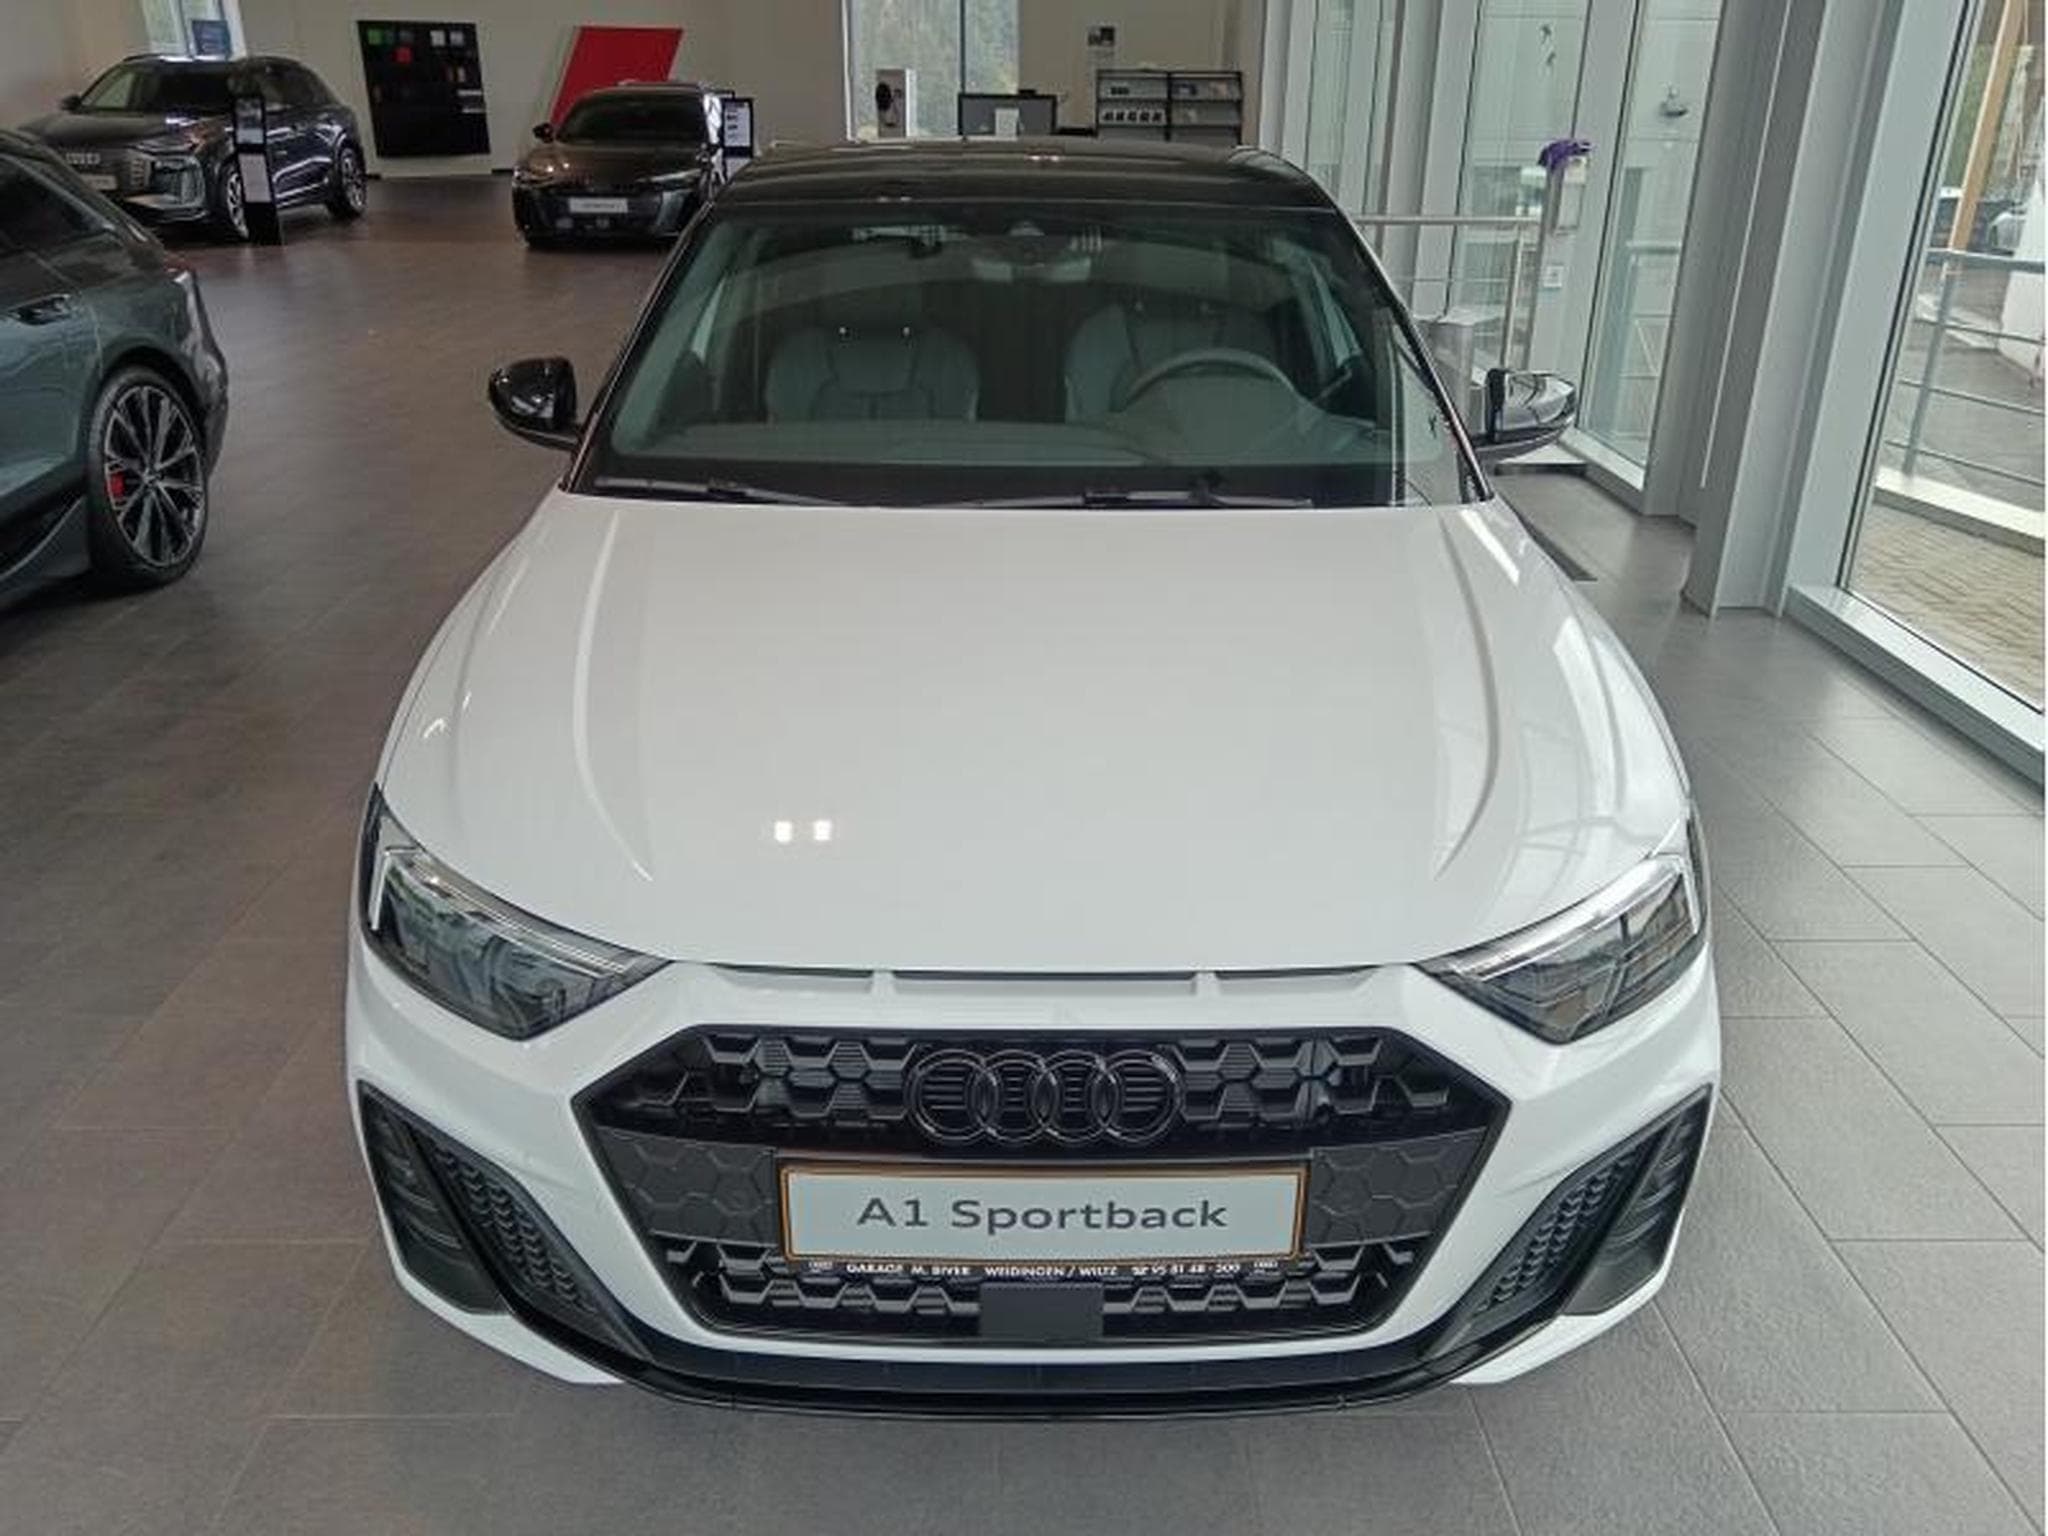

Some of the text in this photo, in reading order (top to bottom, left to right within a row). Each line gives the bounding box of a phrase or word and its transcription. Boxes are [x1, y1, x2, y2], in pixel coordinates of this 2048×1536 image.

[856, 1197, 1227, 1236] A1 Sportback
[846, 1263, 903, 1274] GARAGE
